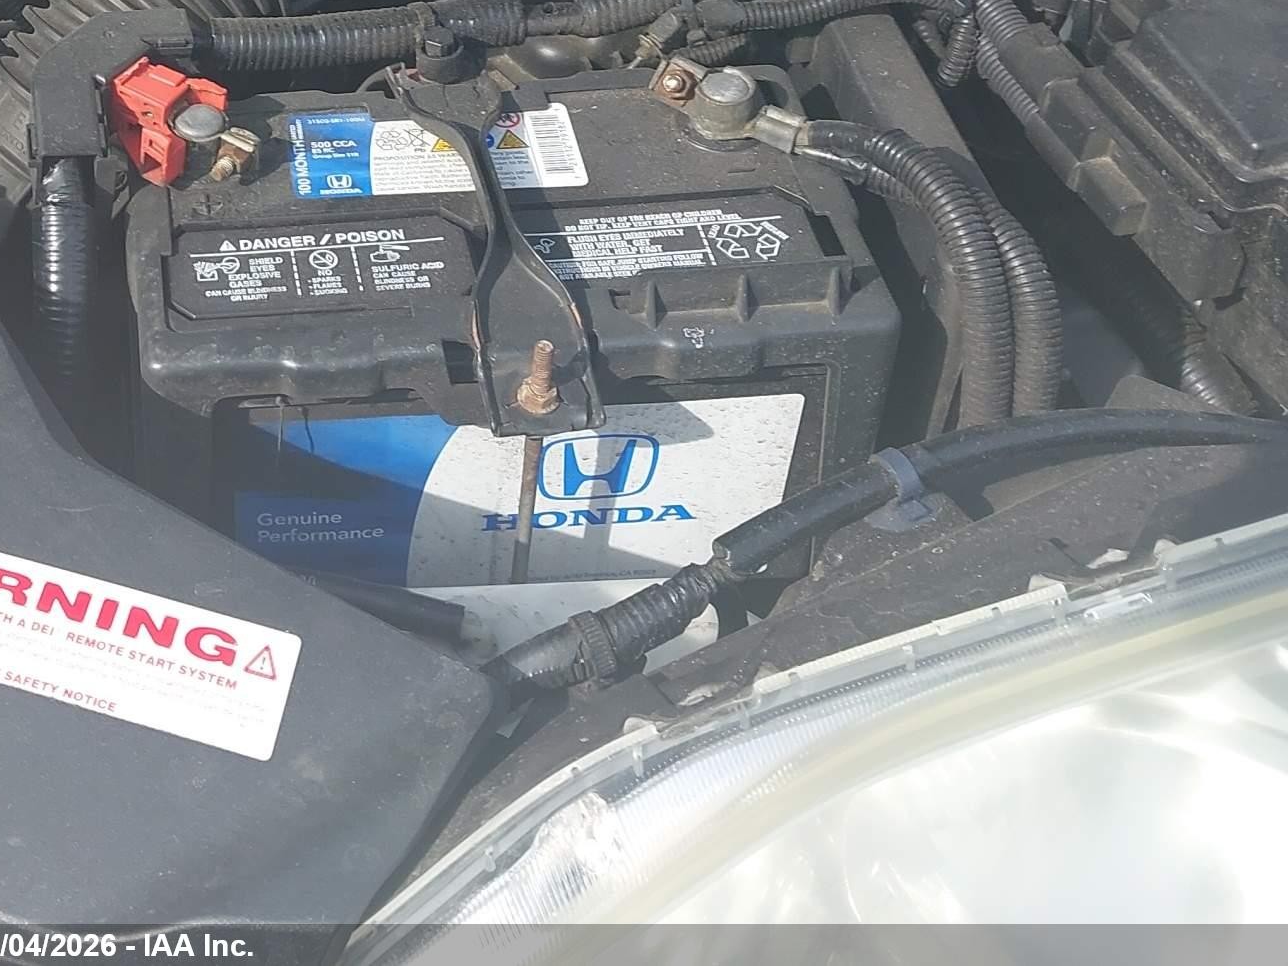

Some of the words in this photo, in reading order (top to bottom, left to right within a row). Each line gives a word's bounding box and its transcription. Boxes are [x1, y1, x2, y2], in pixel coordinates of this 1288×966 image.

[311, 141, 331, 149] 500
[333, 140, 357, 148] CCA
[294, 139, 309, 177] MONTH
[297, 178, 312, 196] 100
[239, 235, 316, 250] DANGER
[334, 229, 406, 244] POISON
[567, 235, 598, 244] FLUSH
[598, 233, 622, 242] EYES
[622, 228, 684, 240] IMMEDIATELY
[569, 242, 595, 251] WITH
[632, 238, 652, 247] GET
[572, 248, 614, 258] MEDICAL
[614, 246, 639, 255] HELP
[639, 244, 664, 253] FAST
[248, 256, 284, 265] SHIELD
[371, 263, 420, 273] SULFURIC
[421, 261, 445, 270] ACID
[228, 271, 281, 281] EXPLOSIVE
[249, 264, 276, 273] EYES
[228, 279, 263, 288] GASES
[256, 511, 342, 526] Genuine
[481, 504, 697, 532] HONDA
[257, 527, 385, 543] Performance
[16, 618, 27, 629] A
[31, 621, 55, 636] DEI
[66, 631, 124, 657] REMOTE
[128, 650, 176, 672] START
[179, 665, 237, 690] SYSTEM
[4, 670, 60, 694] SAFETY
[63, 689, 118, 713] NOTICE
